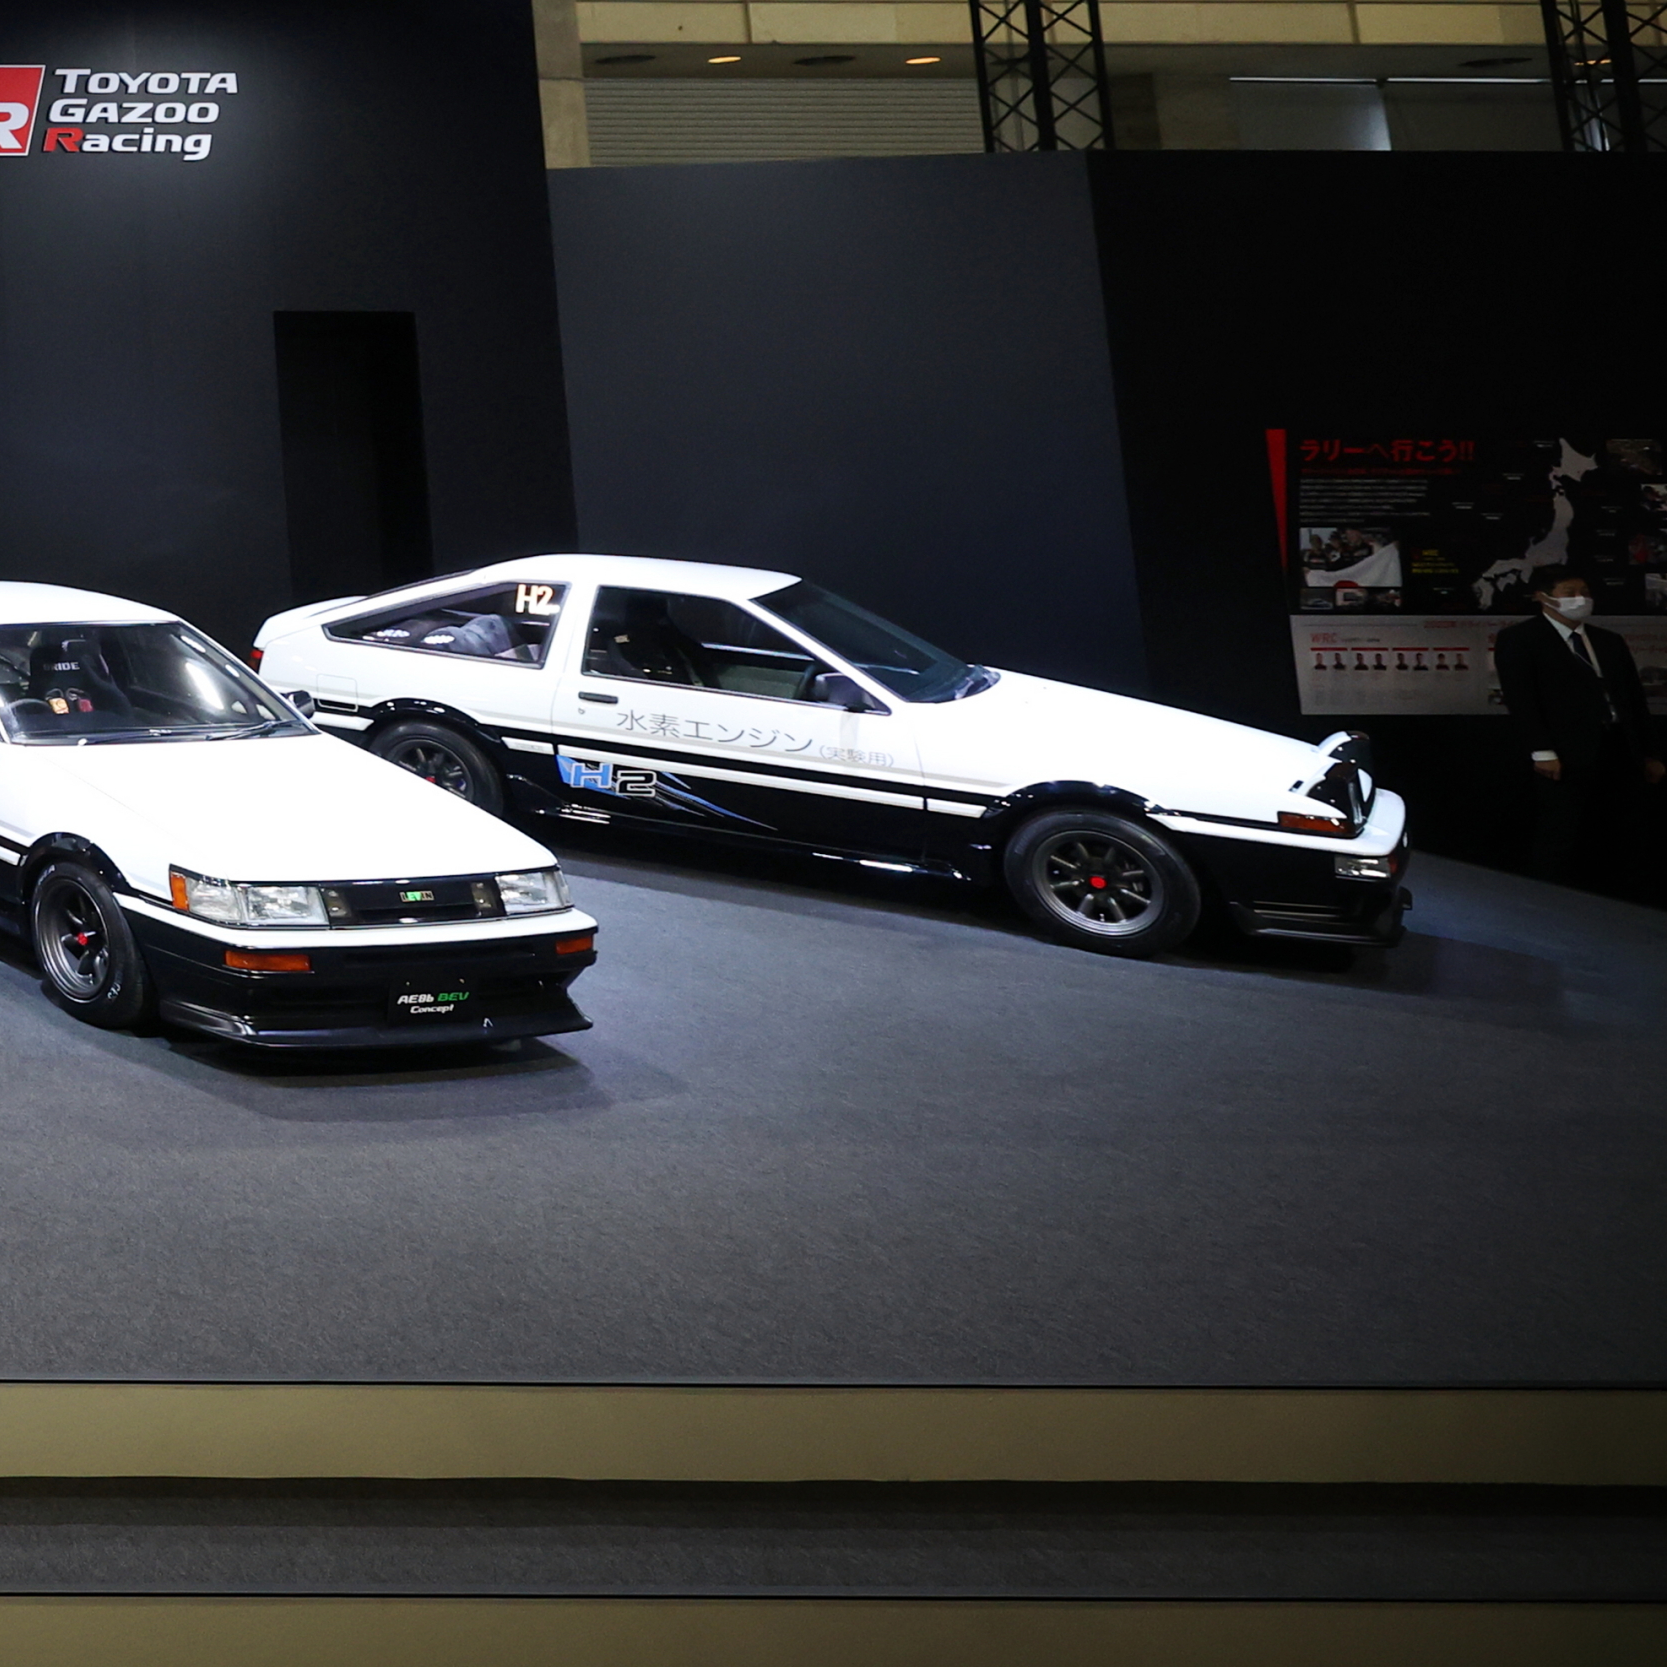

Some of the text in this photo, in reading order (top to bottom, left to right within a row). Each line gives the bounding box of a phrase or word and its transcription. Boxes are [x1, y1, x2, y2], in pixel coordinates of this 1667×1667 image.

[53, 68, 238, 95] TOYOTA
[47, 97, 220, 124] GAZOO
[41, 126, 212, 161] Racing
[515, 584, 555, 616] H2
[616, 710, 814, 753] 水素エンジン
[569, 762, 657, 799] H2
[400, 891, 435, 903] LEVIN
[410, 1003, 455, 1014] Concept
[437, 991, 470, 1002] BEV
